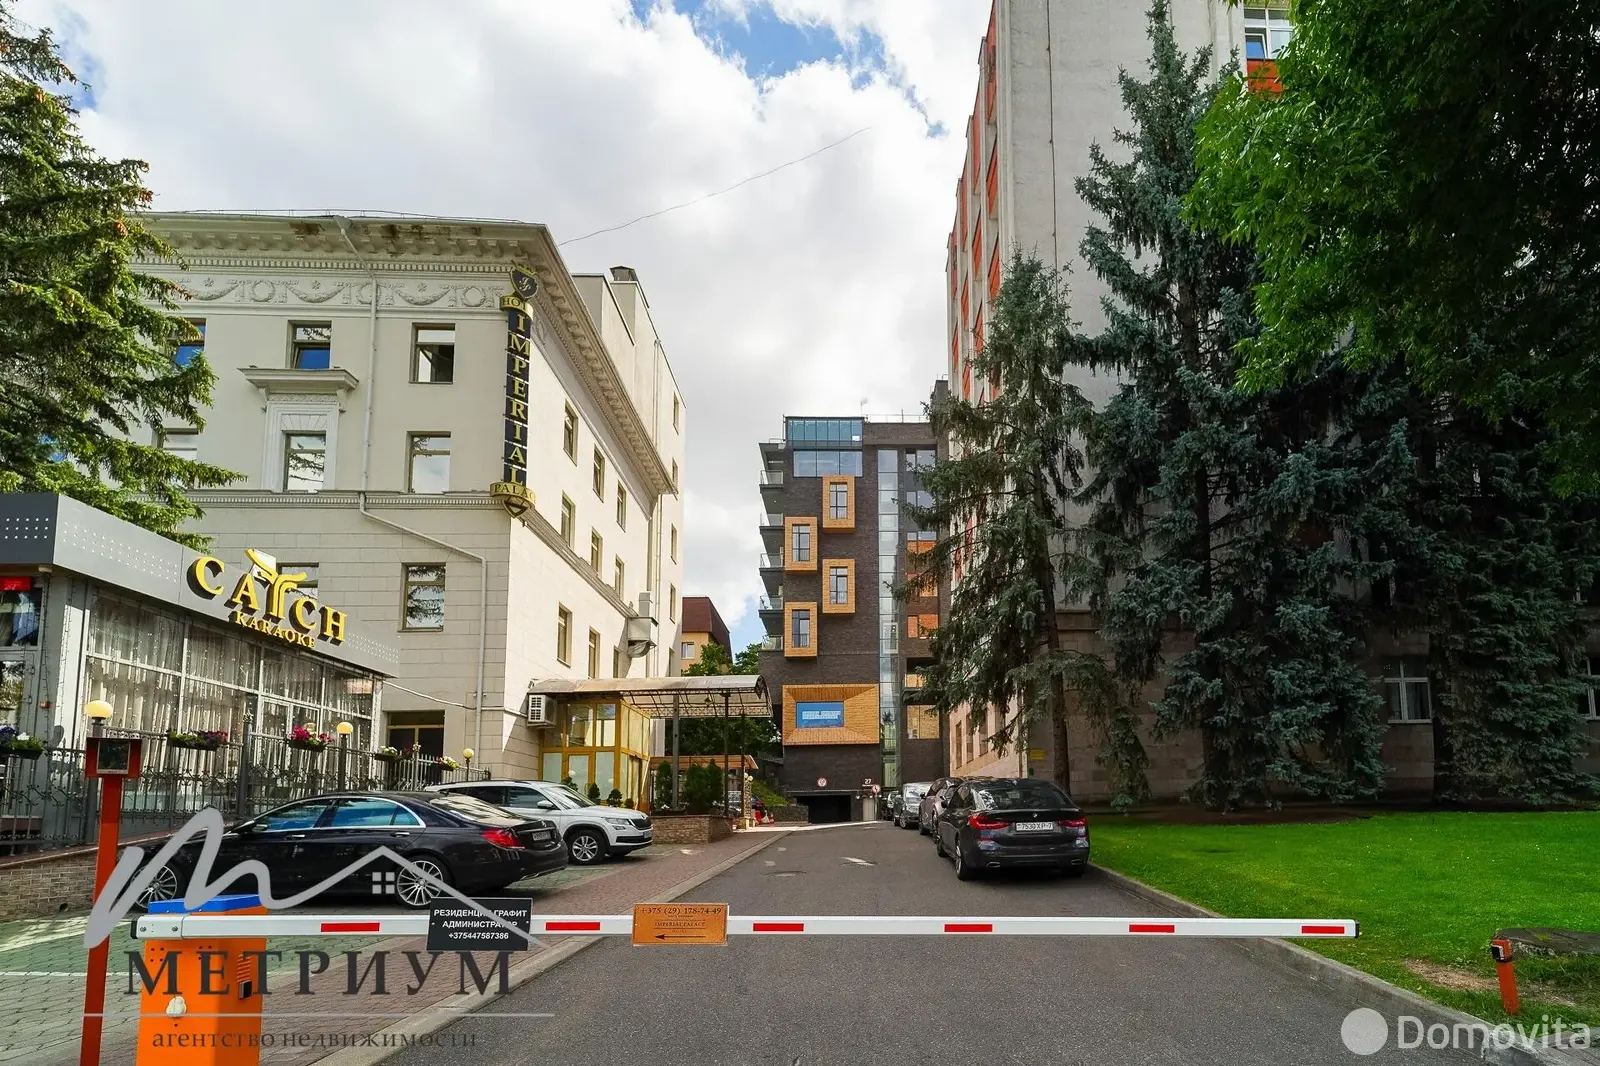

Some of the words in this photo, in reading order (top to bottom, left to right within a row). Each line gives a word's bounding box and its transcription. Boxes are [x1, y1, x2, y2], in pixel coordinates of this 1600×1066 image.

[508, 313, 530, 487] IMPERIAL
[188, 548, 347, 645] CATCH
[232, 609, 315, 648] KARAOKE
[433, 909, 492, 917] РЕЗИДЕНЦ
[493, 909, 527, 917] ГРАФИТ
[663, 907, 681, 916] (29)
[442, 920, 518, 928] АДМИНИСТРАР
